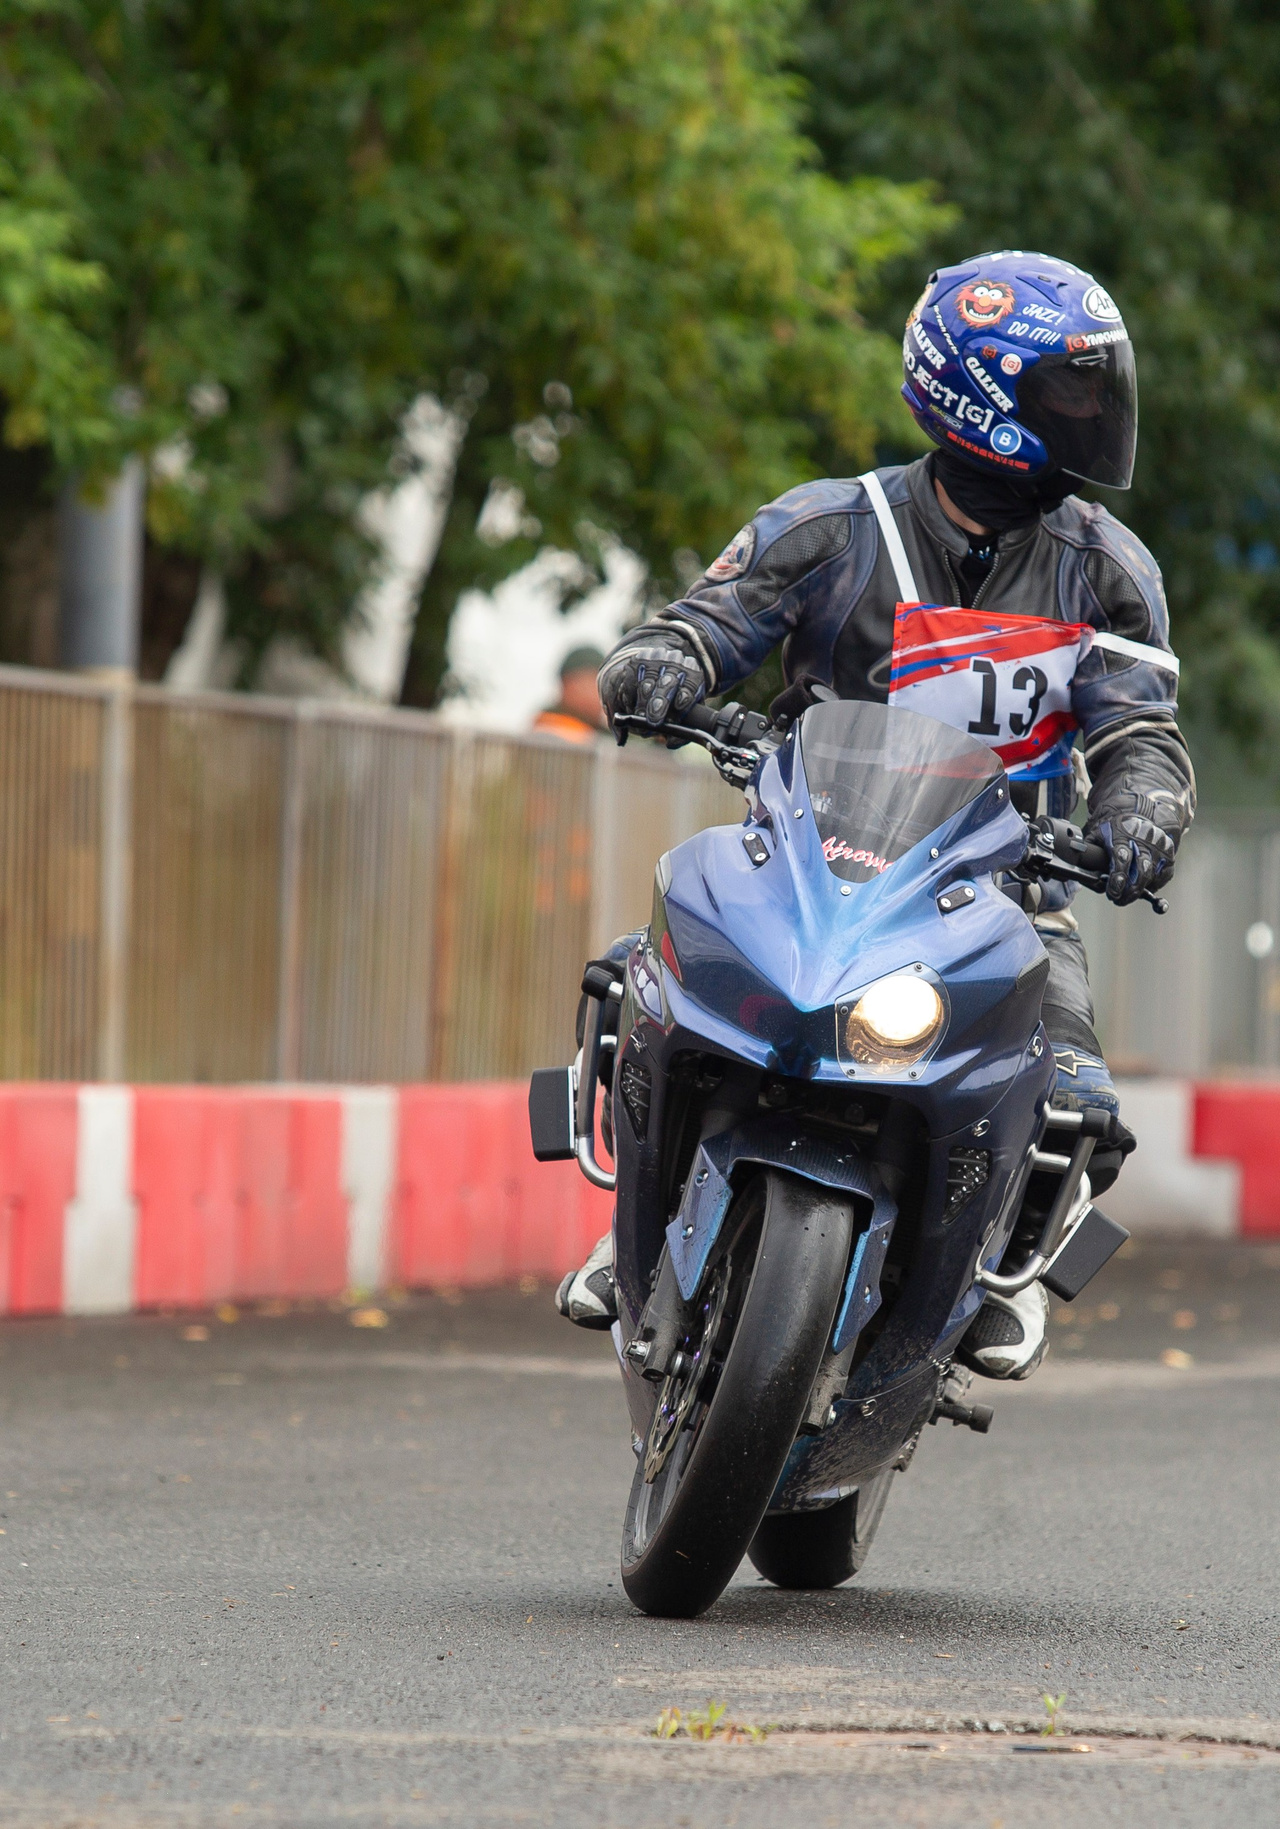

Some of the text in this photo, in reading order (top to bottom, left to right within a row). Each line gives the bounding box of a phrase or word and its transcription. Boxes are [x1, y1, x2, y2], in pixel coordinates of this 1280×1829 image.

[1007, 321, 1061, 346] DO IT!!!
[966, 357, 1014, 412] GALFER
[999, 432, 1012, 447] B
[967, 659, 1048, 737] 13
